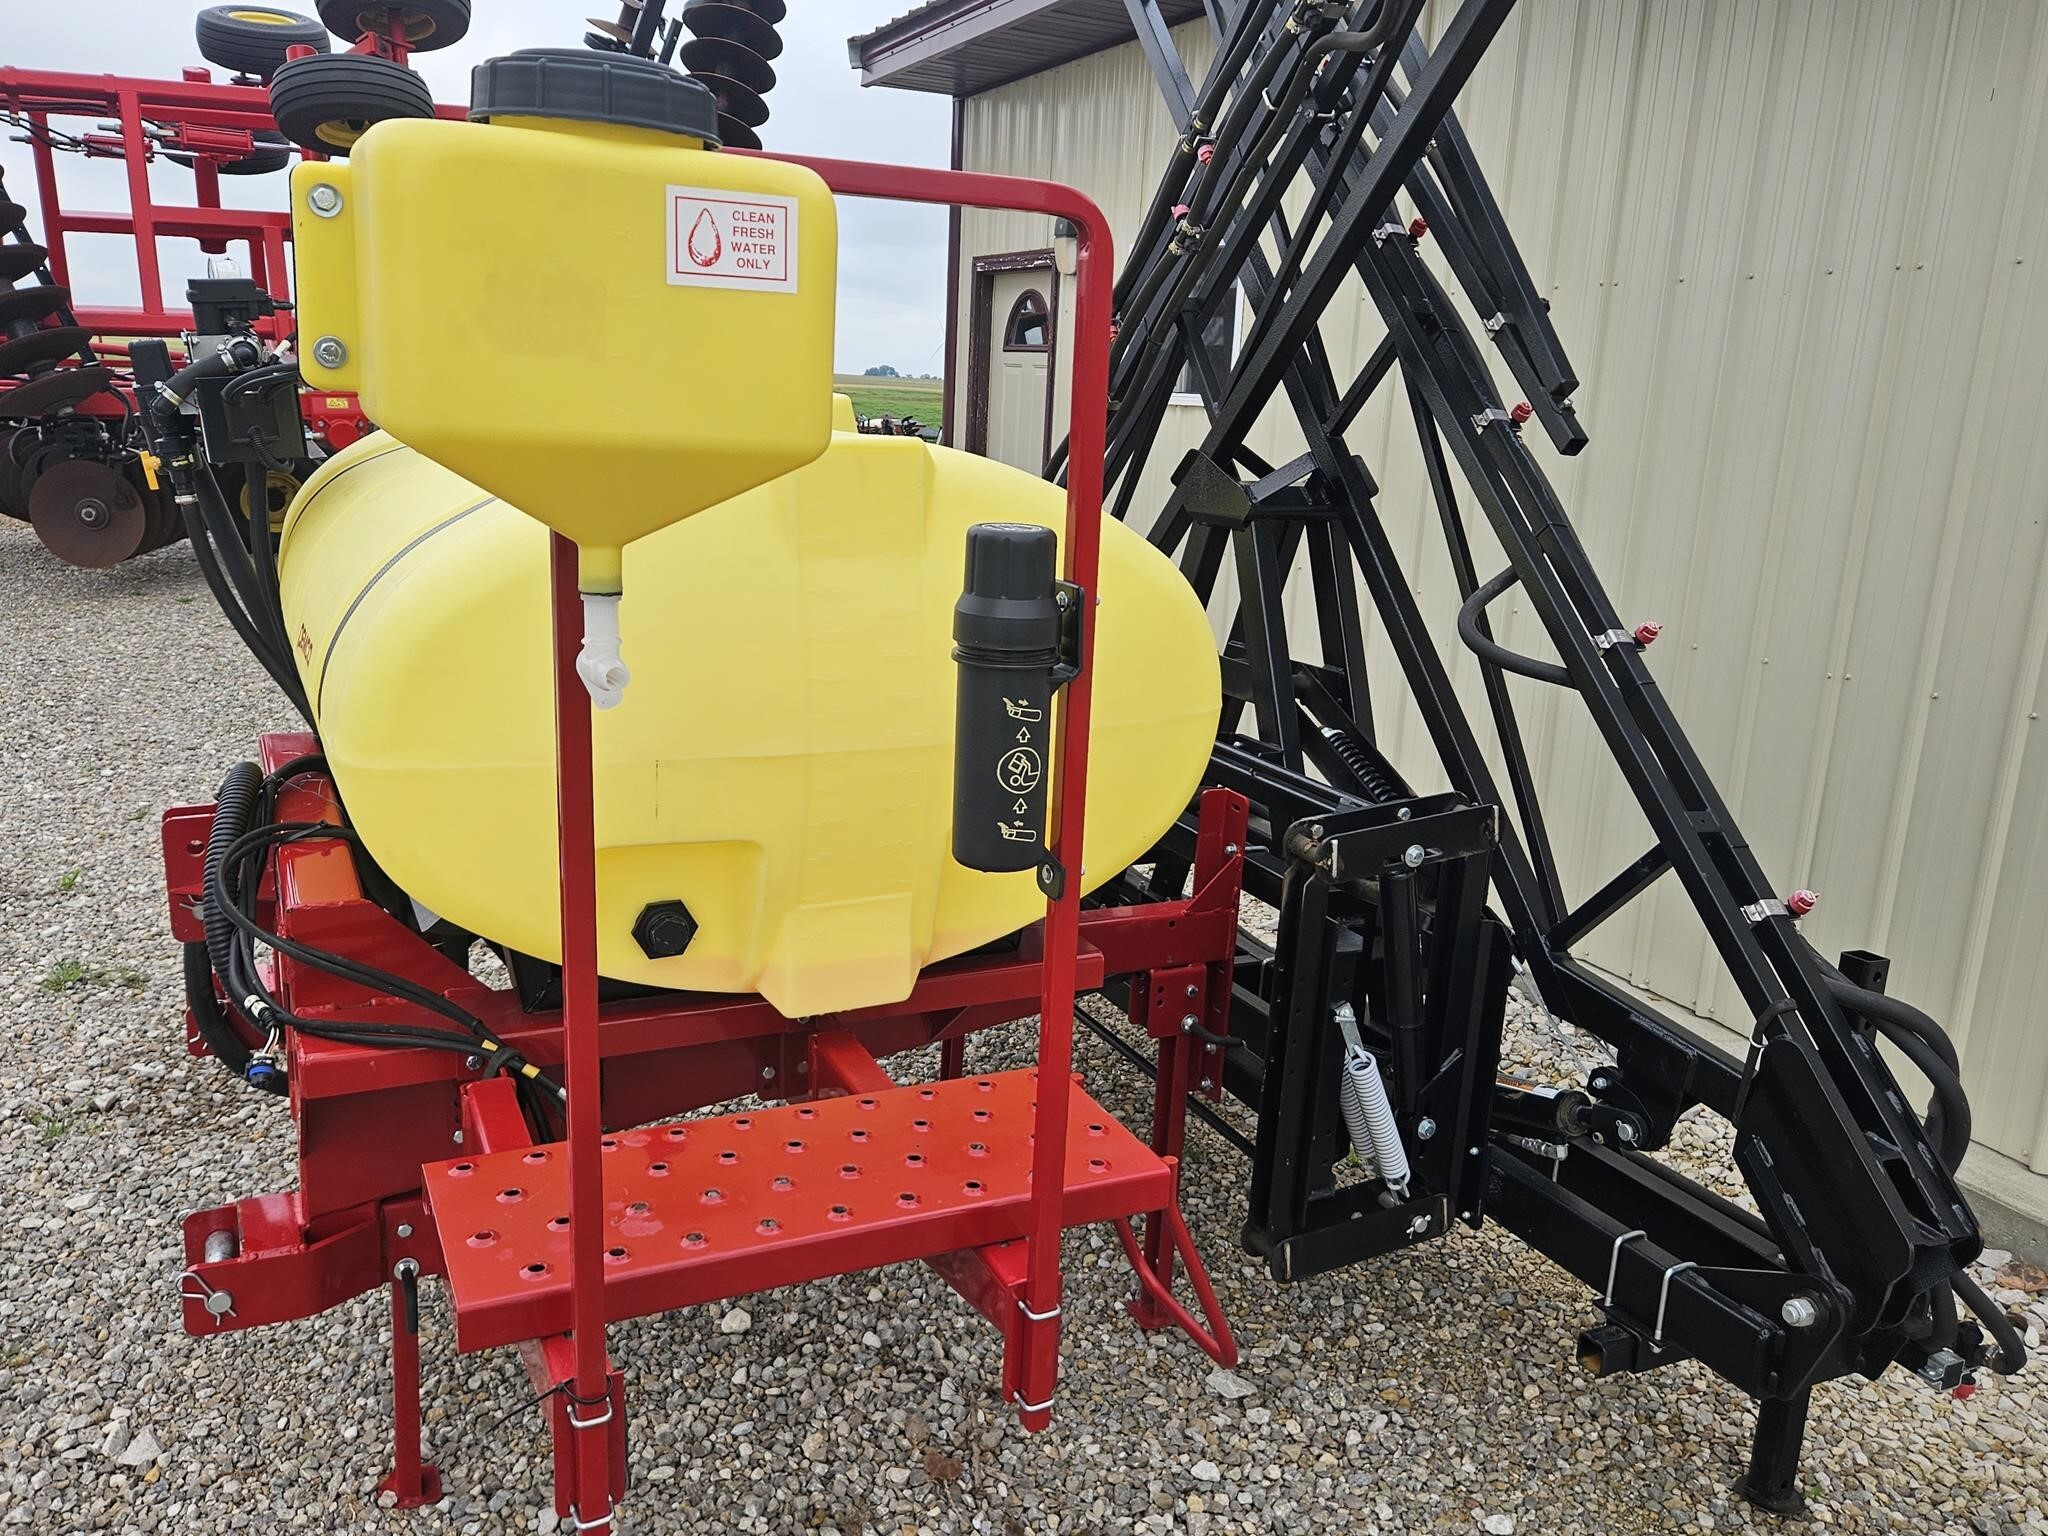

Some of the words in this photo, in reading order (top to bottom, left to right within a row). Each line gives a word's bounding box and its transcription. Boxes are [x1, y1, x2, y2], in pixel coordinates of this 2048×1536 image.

[732, 210, 775, 224] CLEAN
[732, 226, 774, 239] FRESH
[731, 242, 776, 255] WATER
[736, 258, 771, 270] ONLY
